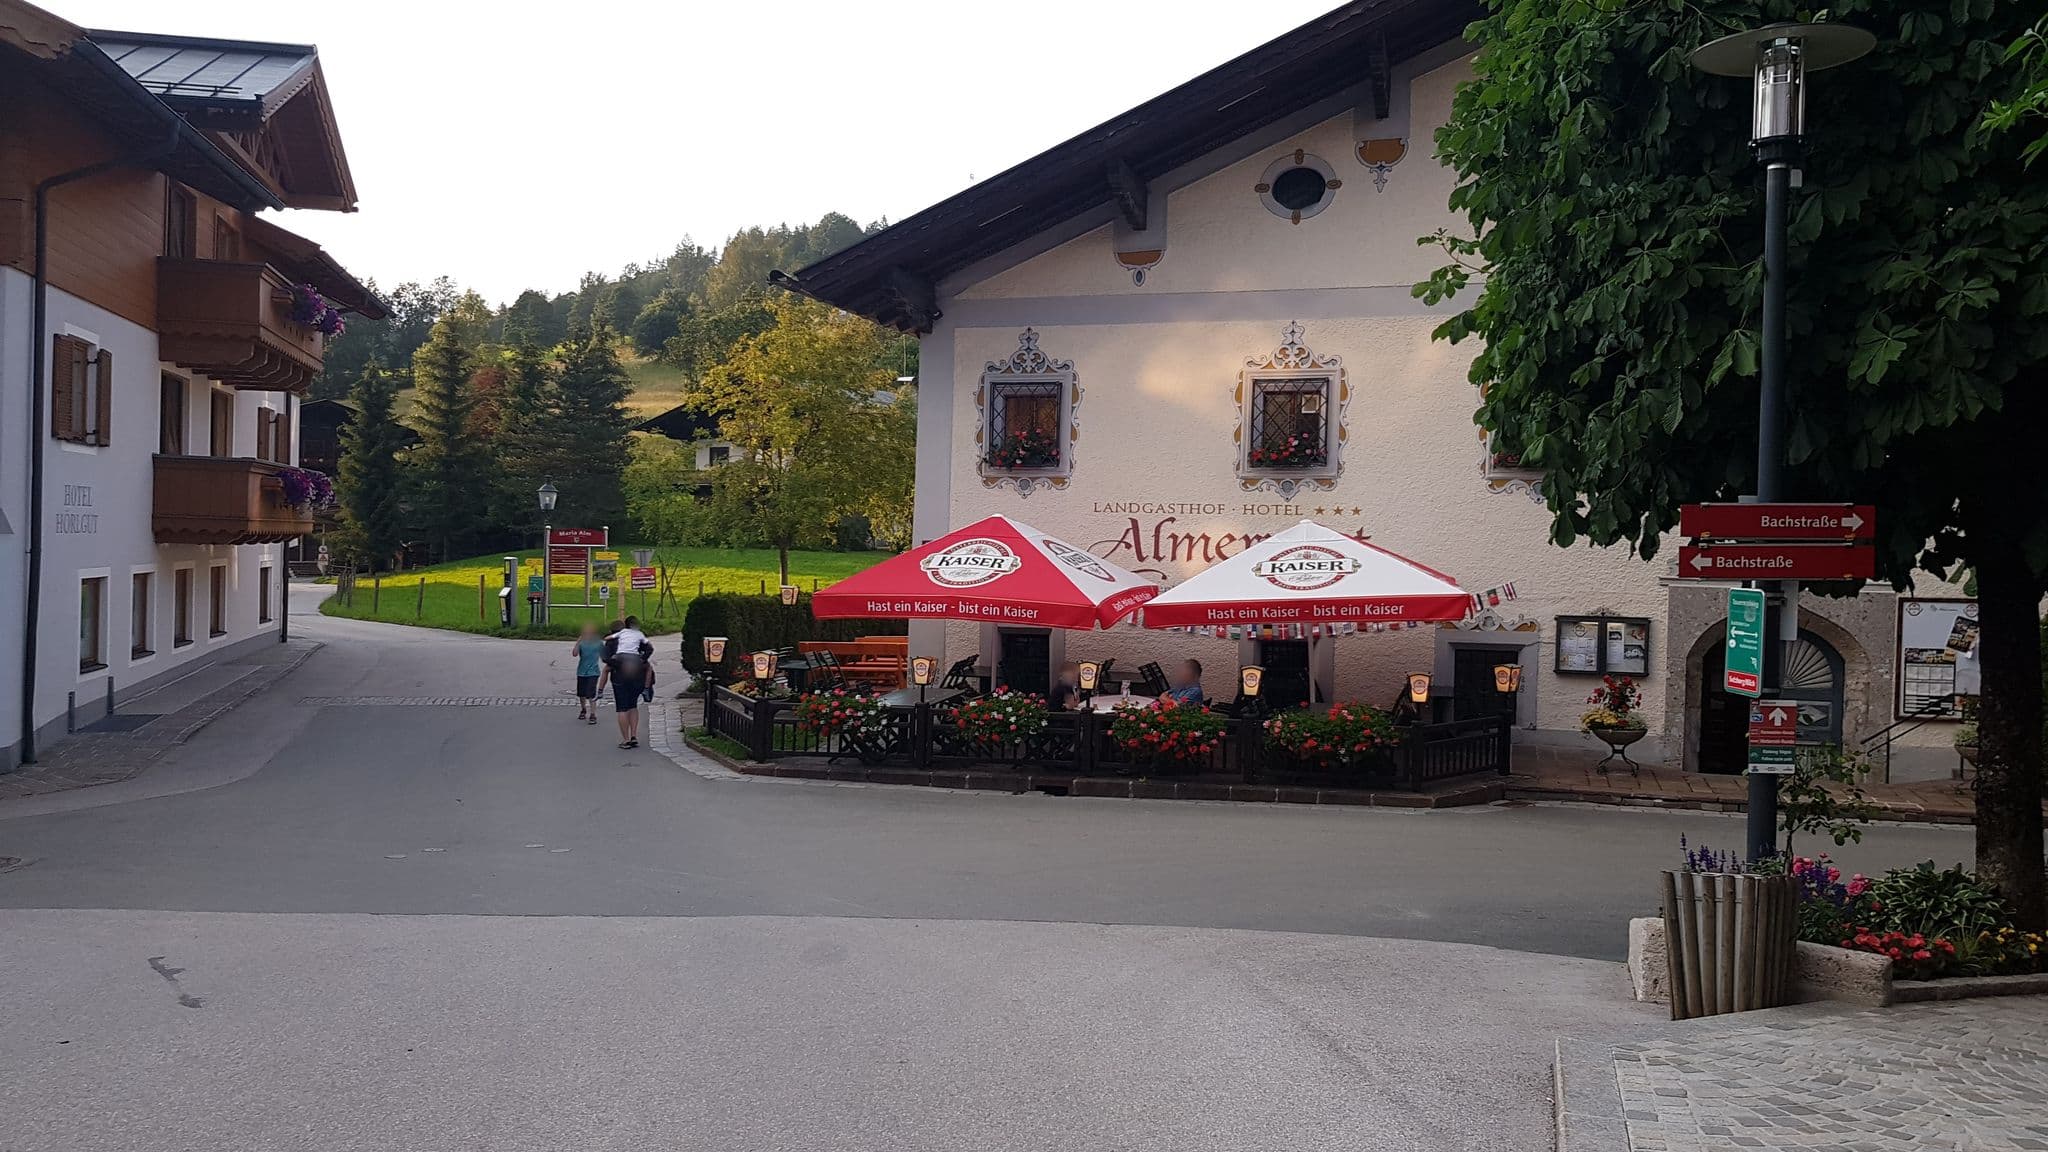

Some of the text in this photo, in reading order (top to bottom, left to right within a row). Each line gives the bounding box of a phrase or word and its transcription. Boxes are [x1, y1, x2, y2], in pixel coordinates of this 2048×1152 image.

[63, 484, 93, 507] HOTEL
[1093, 502, 1304, 516] LANDGASTHOF HOTEL
[55, 510, 99, 534] HÖRLGUT
[1760, 515, 1838, 528] Bachstraße
[937, 556, 1005, 569] KAISER
[1270, 560, 1345, 574] KAISER
[1716, 556, 1794, 569] Bachstraße
[867, 601, 891, 612] Hast
[894, 601, 912, 612] ein
[914, 601, 948, 613] Kaiser
[958, 602, 979, 614] bist
[982, 604, 1000, 616] ein
[1003, 606, 1039, 619] Kaiser
[1207, 608, 1235, 620] Hast
[1238, 607, 1258, 619] ein
[1262, 606, 1300, 618] Kaiser
[1313, 604, 1336, 617] bist
[1340, 603, 1360, 616] ein
[1364, 602, 1404, 615] Kaiser
